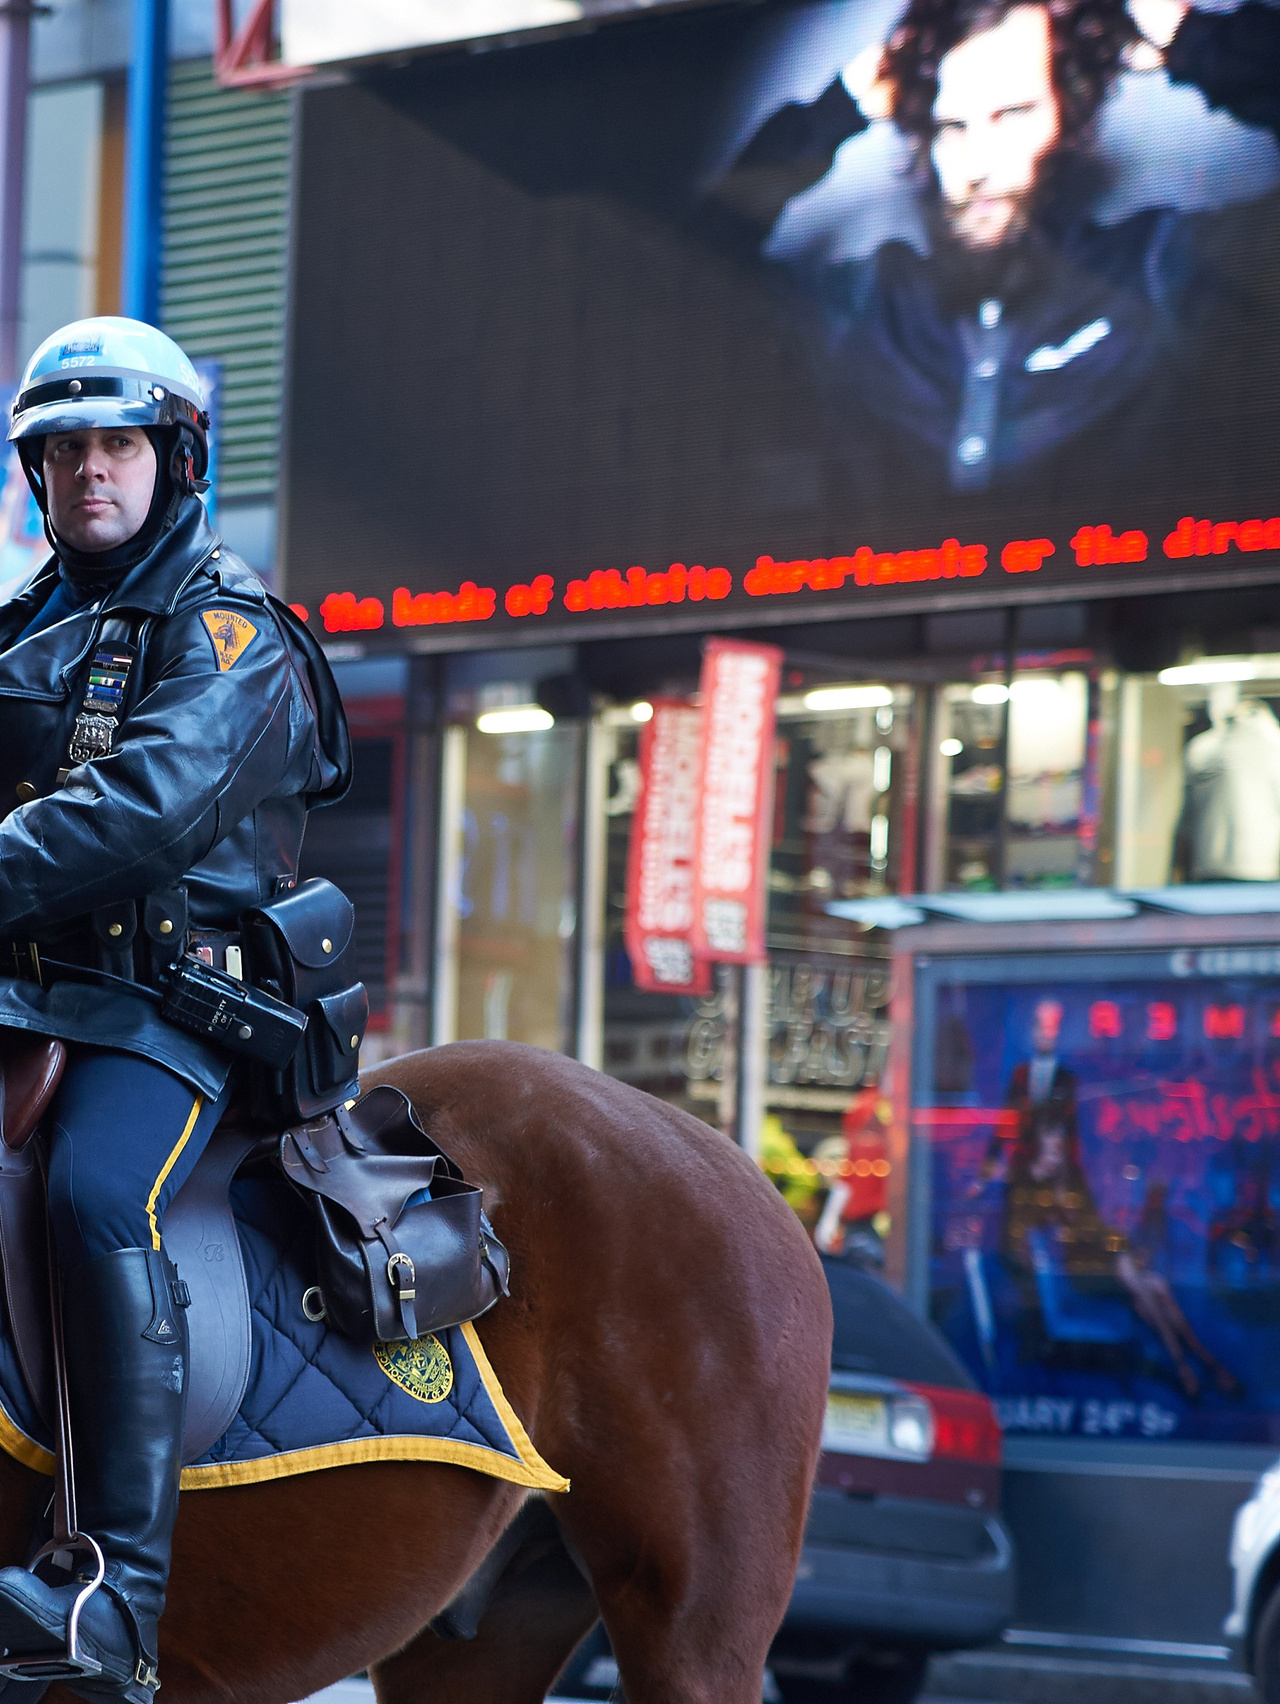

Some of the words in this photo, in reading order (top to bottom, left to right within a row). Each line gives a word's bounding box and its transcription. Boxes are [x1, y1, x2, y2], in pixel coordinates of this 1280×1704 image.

[61, 355, 96, 370] 5572
[320, 592, 384, 633] the
[505, 574, 554, 617] of
[1001, 539, 1055, 573] or
[1070, 524, 1148, 567] the
[213, 612, 248, 629] MOUNTED
[411, 1386, 430, 1399] CITY
